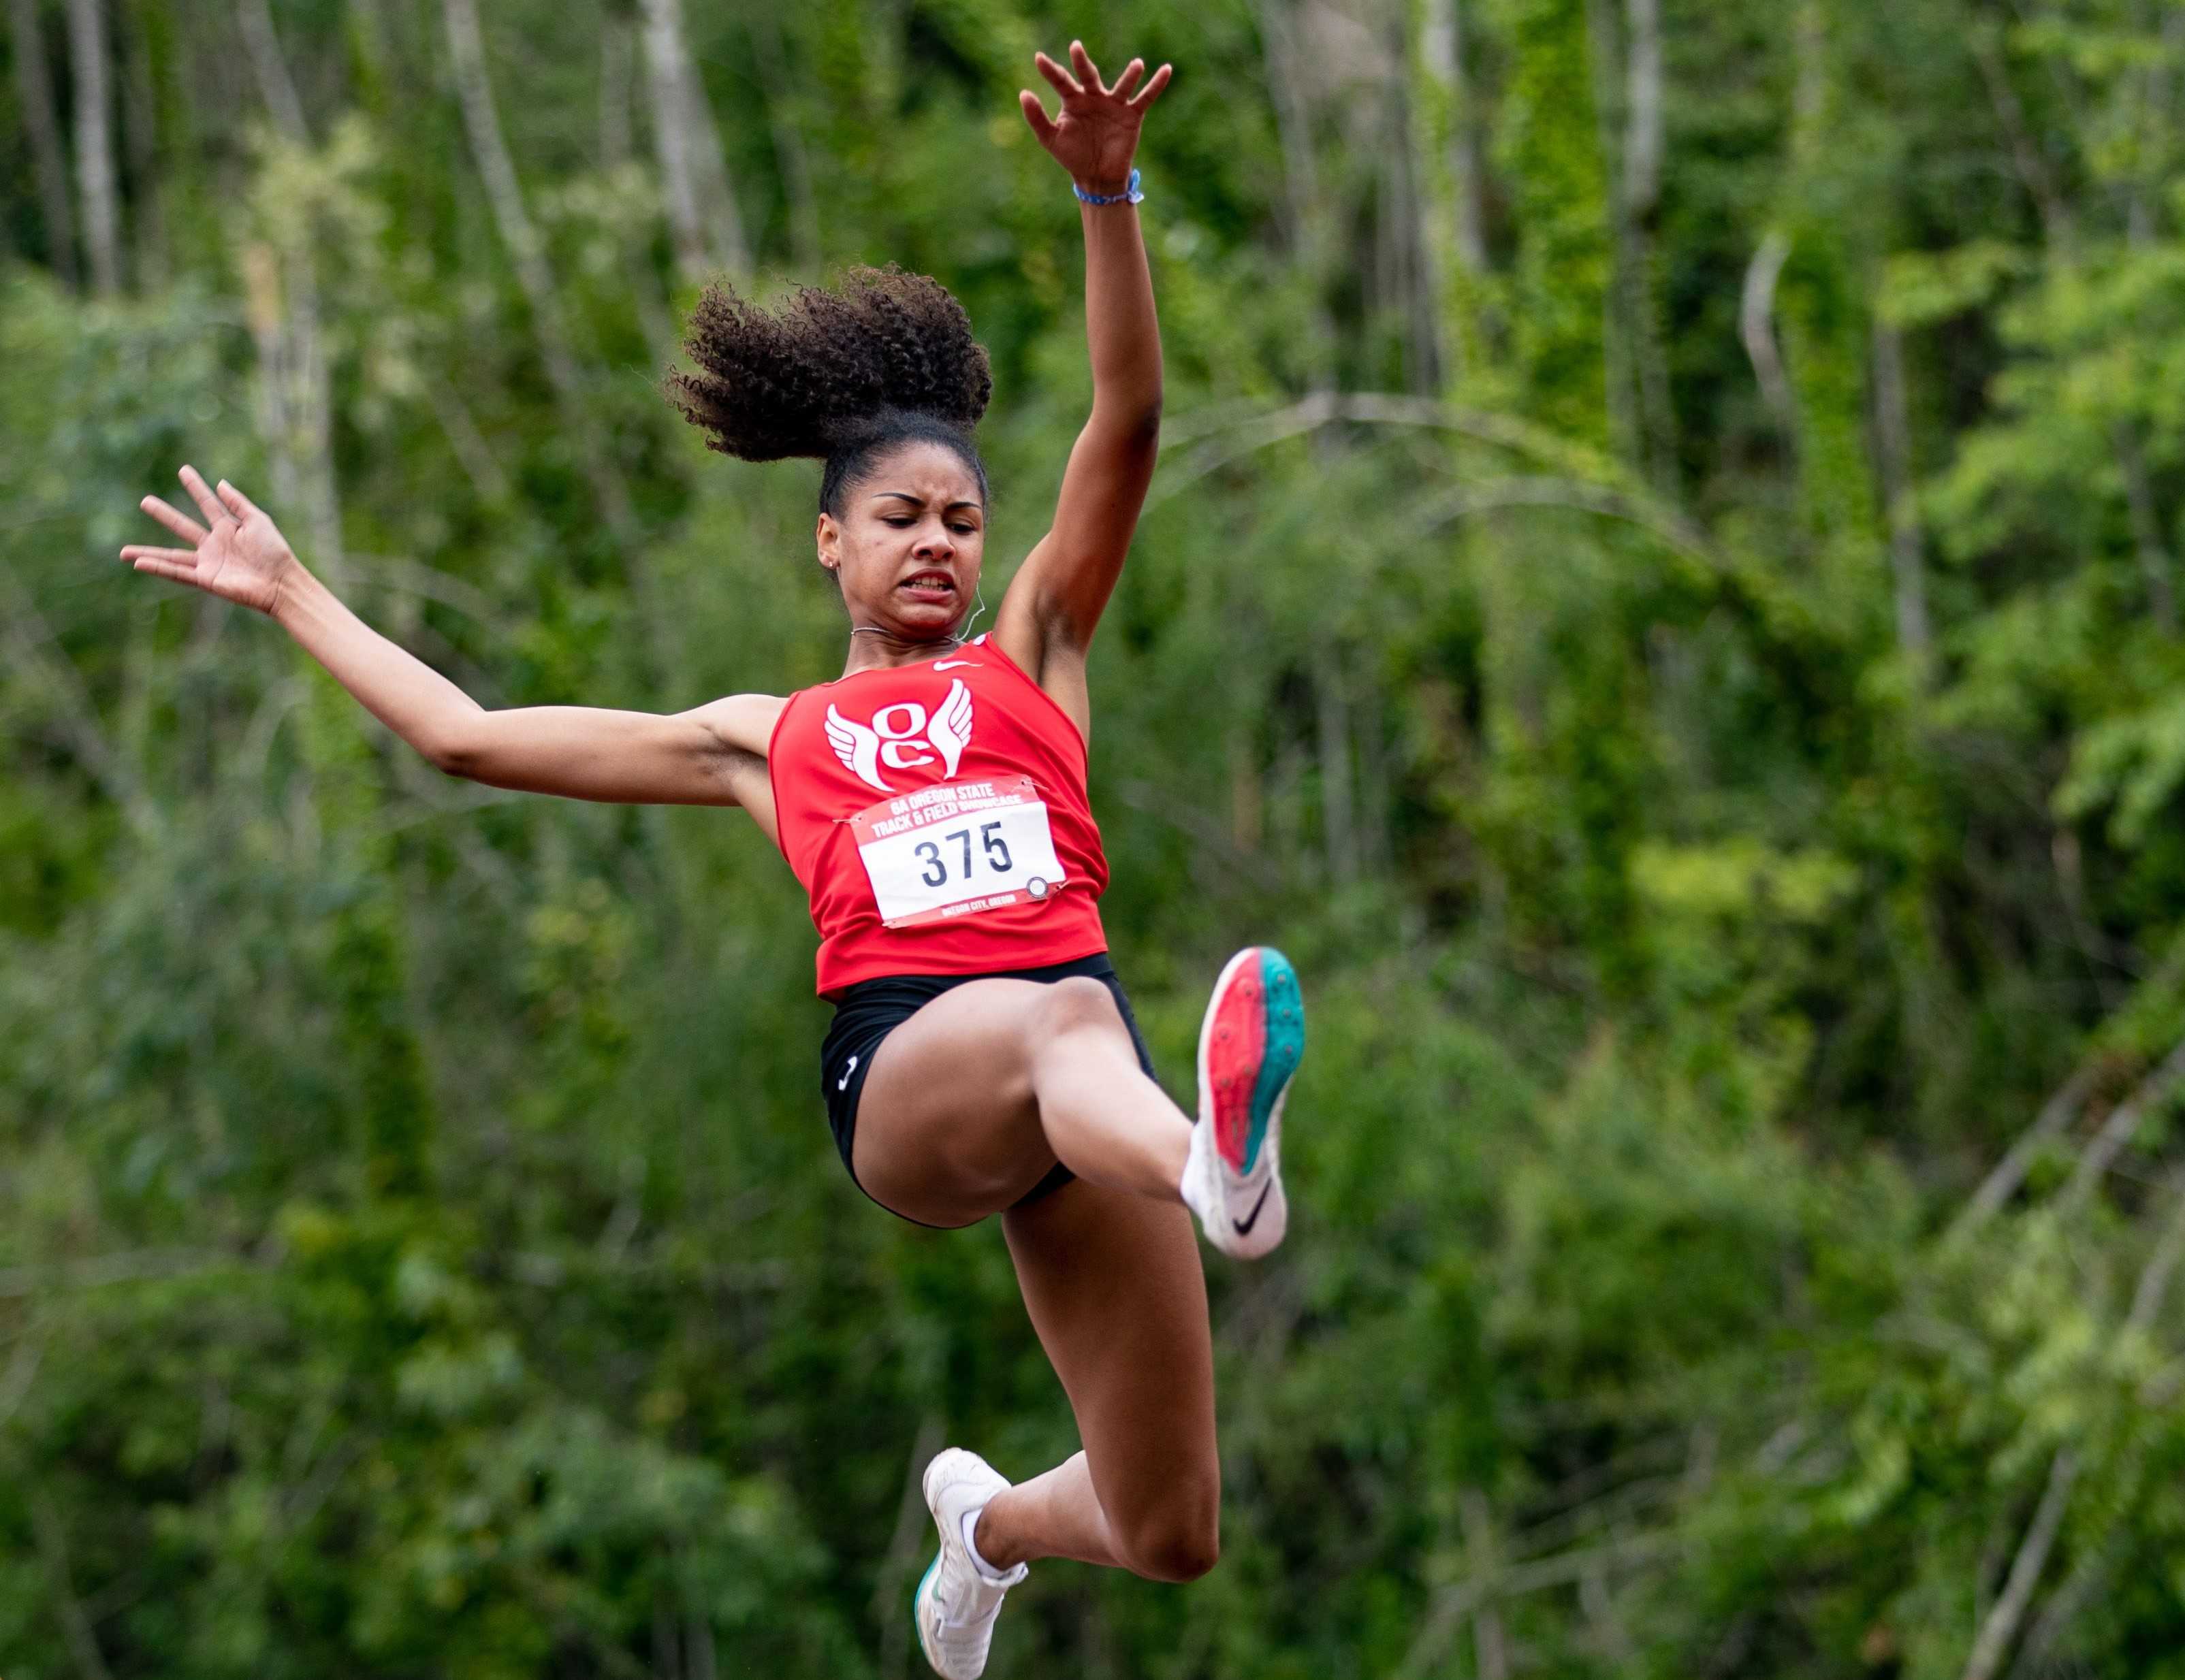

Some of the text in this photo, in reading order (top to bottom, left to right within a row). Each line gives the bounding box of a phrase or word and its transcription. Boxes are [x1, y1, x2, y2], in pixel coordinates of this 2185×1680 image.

[872, 794, 1022, 838] TRACK & FIELD SHOWCASE
[890, 784, 995, 815] 6A OREGON STATE
[914, 821, 1012, 888] 375
